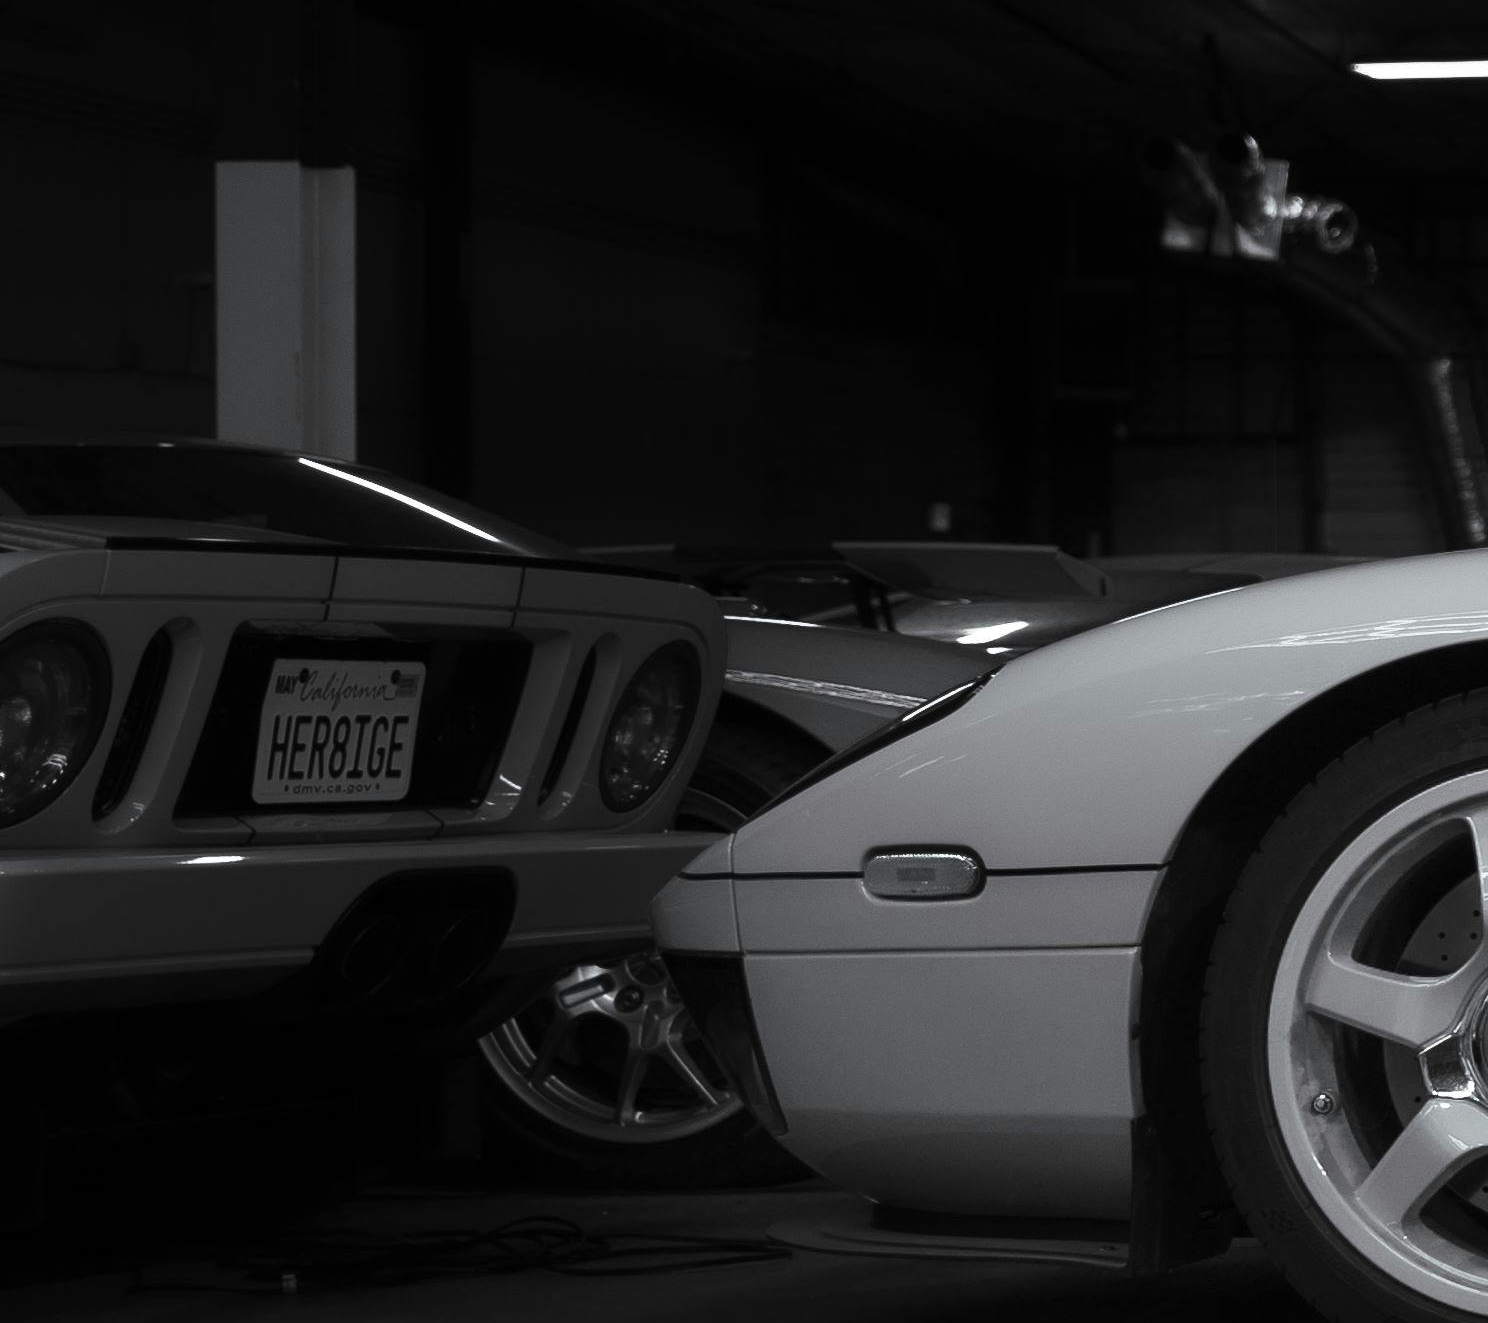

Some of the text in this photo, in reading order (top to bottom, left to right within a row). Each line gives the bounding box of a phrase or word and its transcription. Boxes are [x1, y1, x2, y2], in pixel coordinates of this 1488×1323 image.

[275, 675, 298, 694] MAY
[300, 670, 397, 711] California
[267, 715, 409, 780] HER8IGE
[292, 782, 372, 795] dmv.ca.gov
